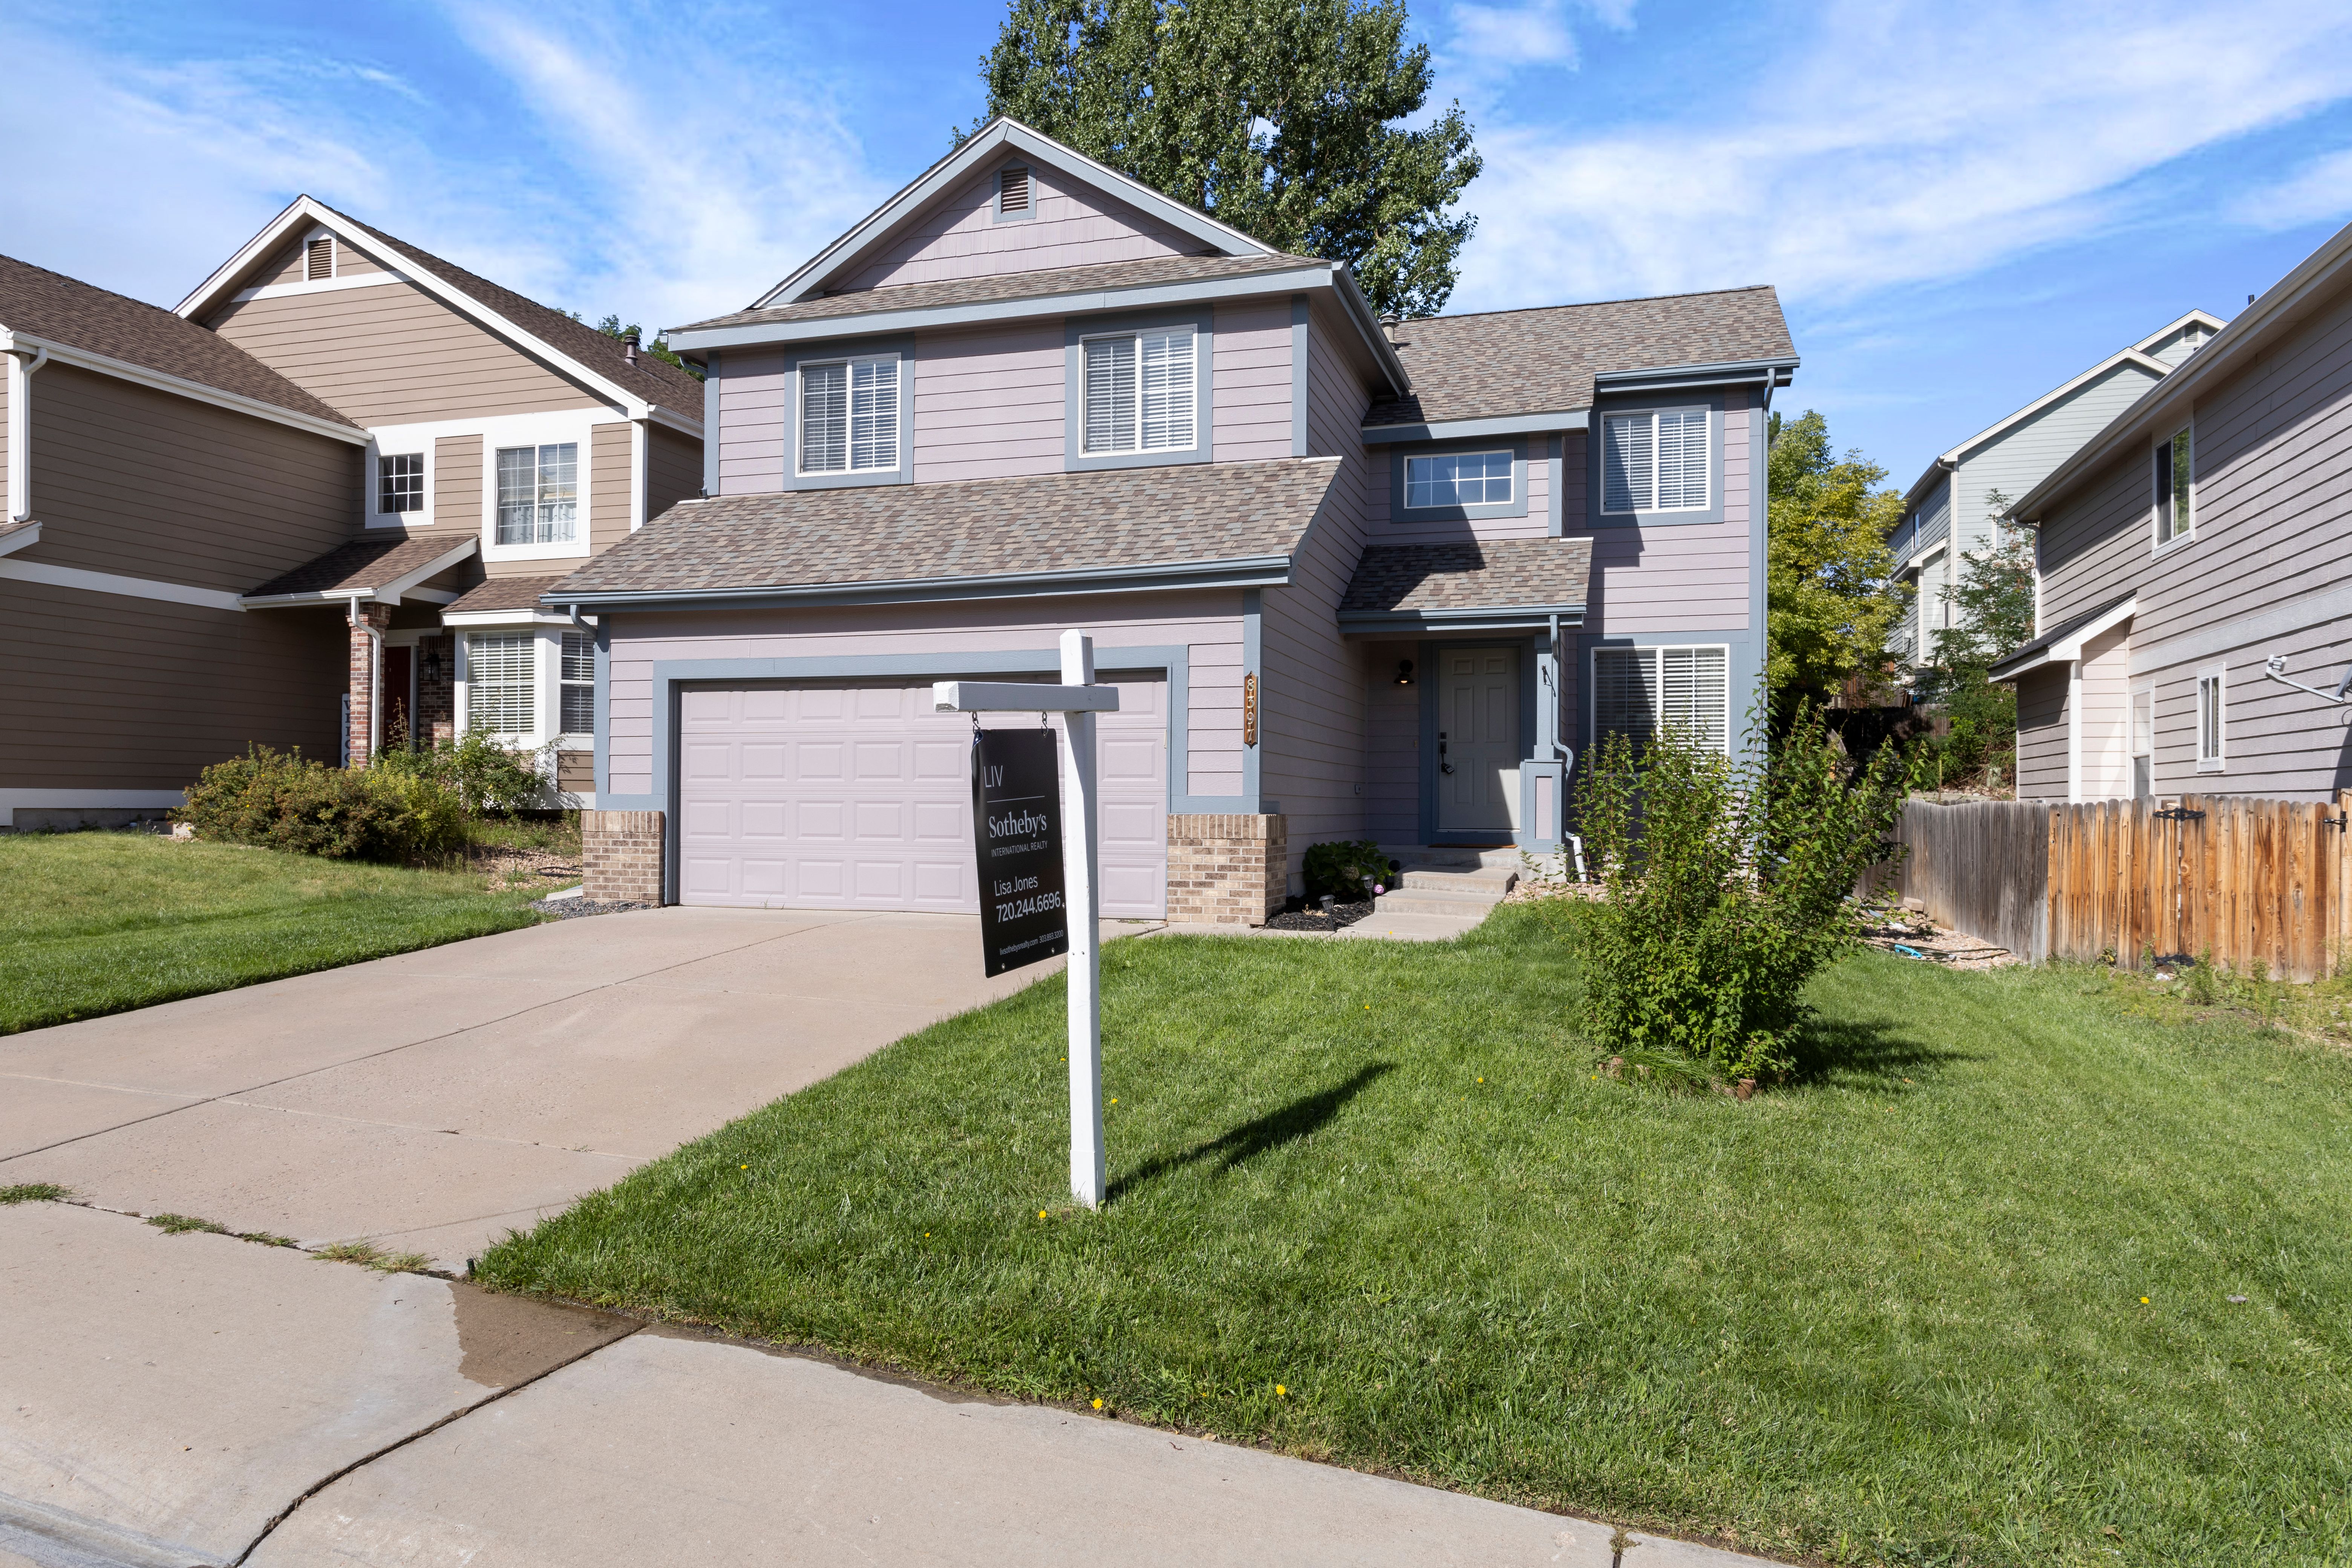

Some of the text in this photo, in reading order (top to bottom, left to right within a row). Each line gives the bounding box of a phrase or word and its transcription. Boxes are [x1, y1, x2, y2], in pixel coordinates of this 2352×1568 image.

[984, 765, 1003, 787] LIV
[989, 810, 1047, 838] Sotheby's
[991, 841, 1047, 858] INTERNATIONAL REALTY
[994, 876, 1038, 896] Lisa Jones
[996, 891, 1061, 923] 720.244.6696
[1000, 929, 1064, 956] livsothebysrealty.com 303.893.3200
